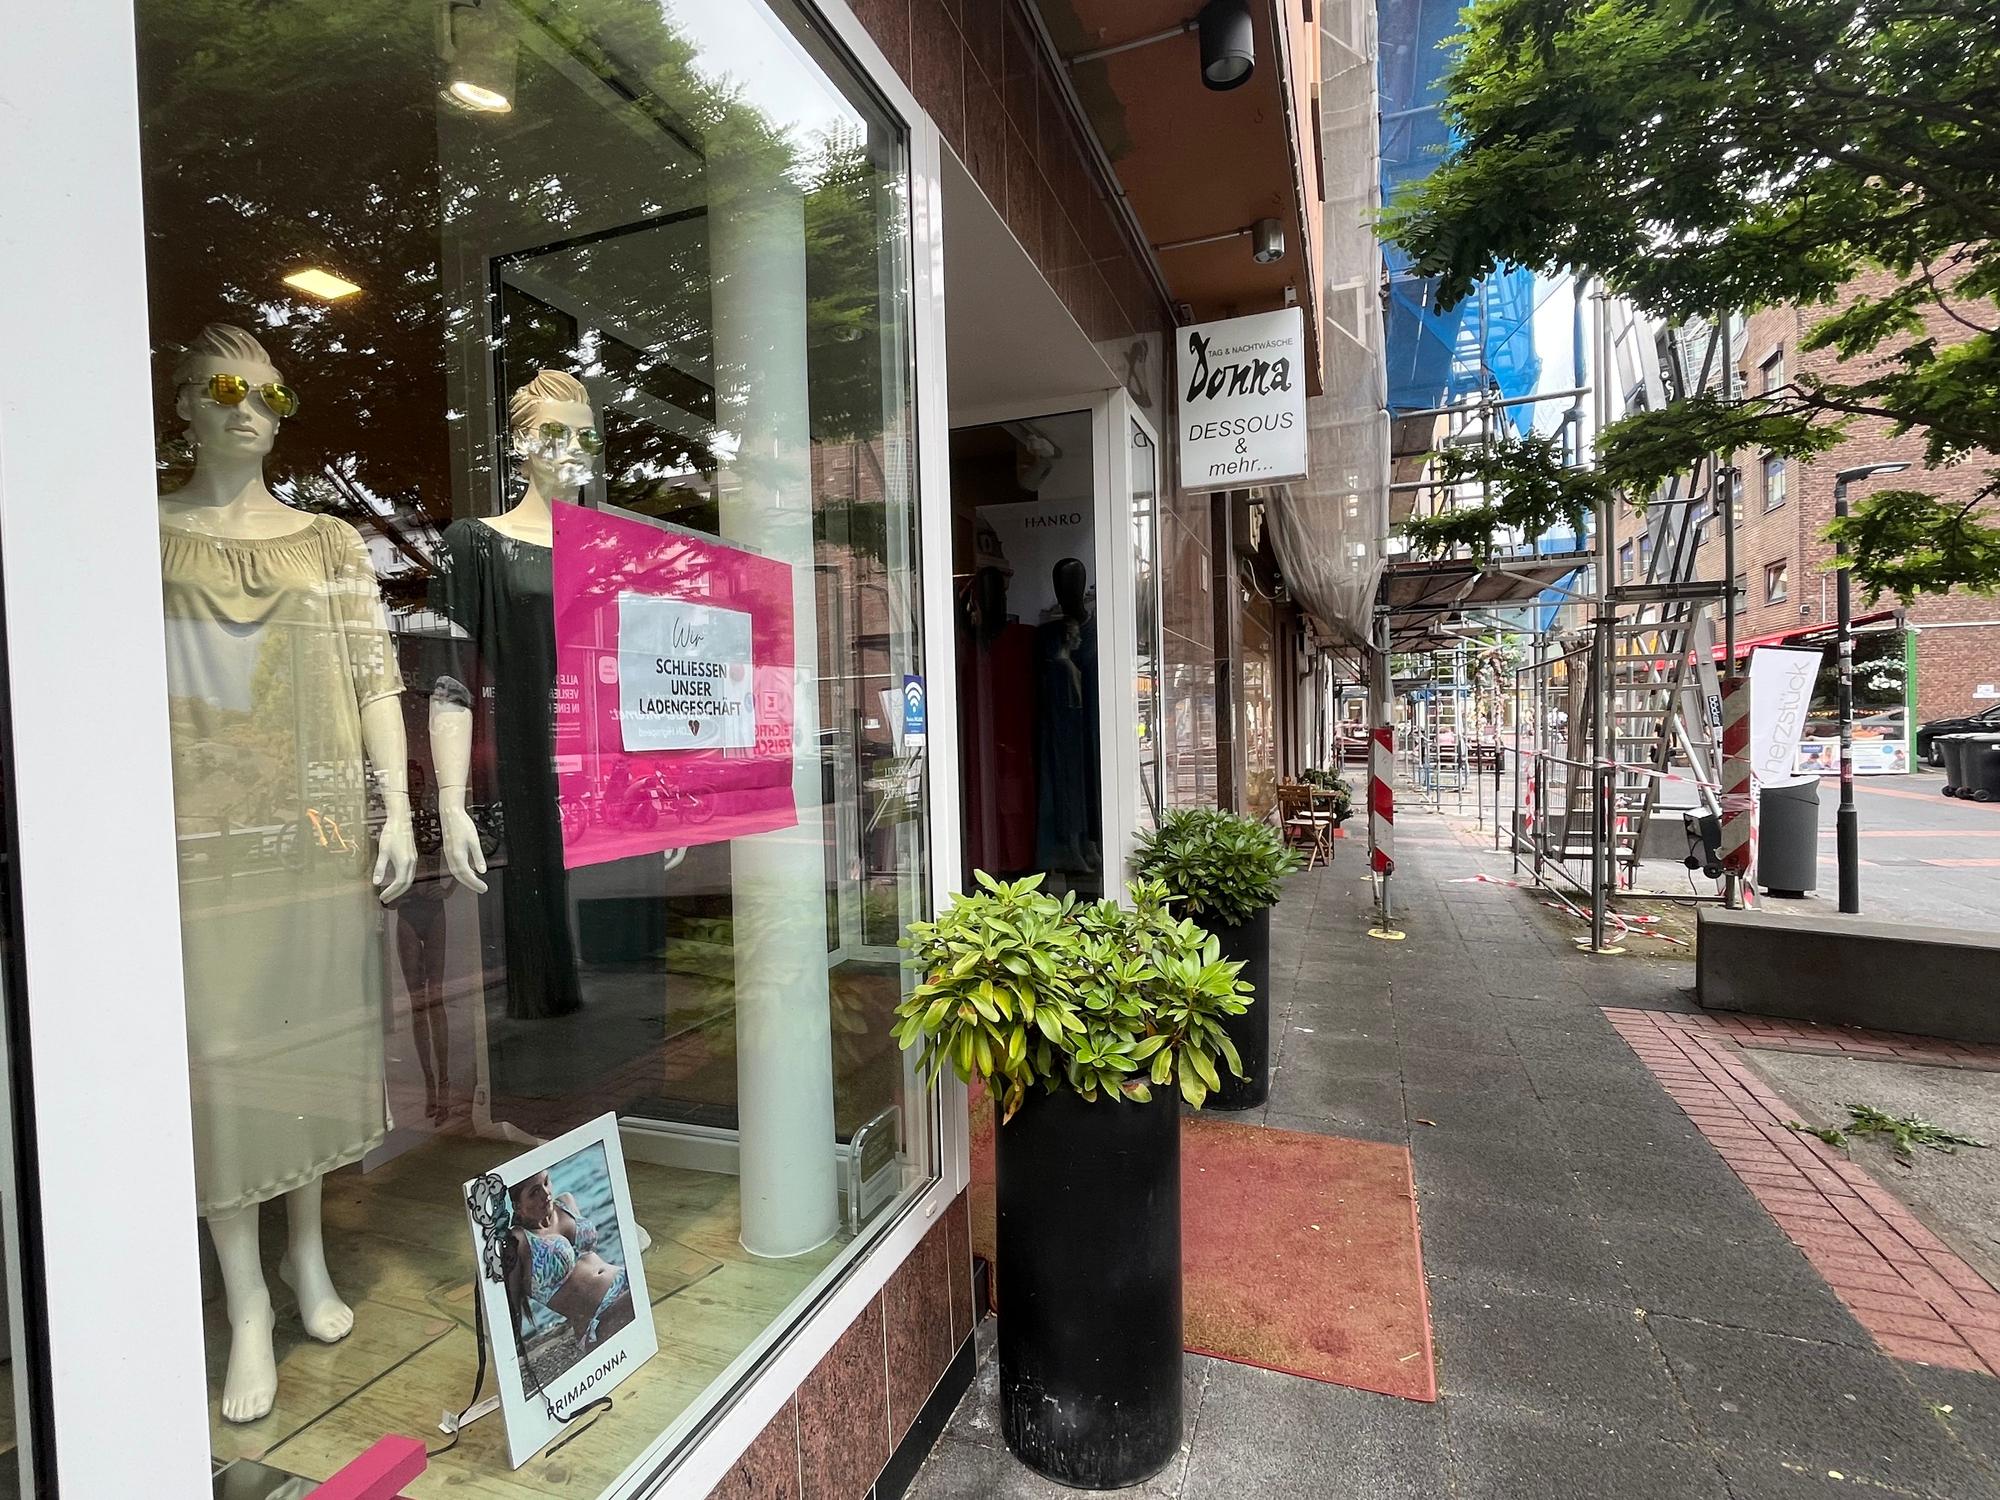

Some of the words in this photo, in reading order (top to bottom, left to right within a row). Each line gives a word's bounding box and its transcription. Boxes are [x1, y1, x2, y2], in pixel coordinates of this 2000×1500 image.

[1208, 348, 1223, 358] TAG
[1224, 347, 1231, 355] &
[1231, 337, 1294, 354] NACHTWÄSCHE
[1186, 331, 1292, 403] Donna
[1188, 411, 1294, 442] DESSOUS
[1234, 437, 1248, 454] &
[1209, 457, 1273, 477] mehr...
[1024, 512, 1082, 528] HANRO
[672, 616, 704, 649] Wir
[656, 658, 727, 679] SCHLIESSEN
[671, 679, 713, 697] UNSER
[639, 696, 742, 716] LADENGESCHÄFT
[1760, 661, 1811, 774] herzstück
[547, 1349, 628, 1421] PRIMADONNA
